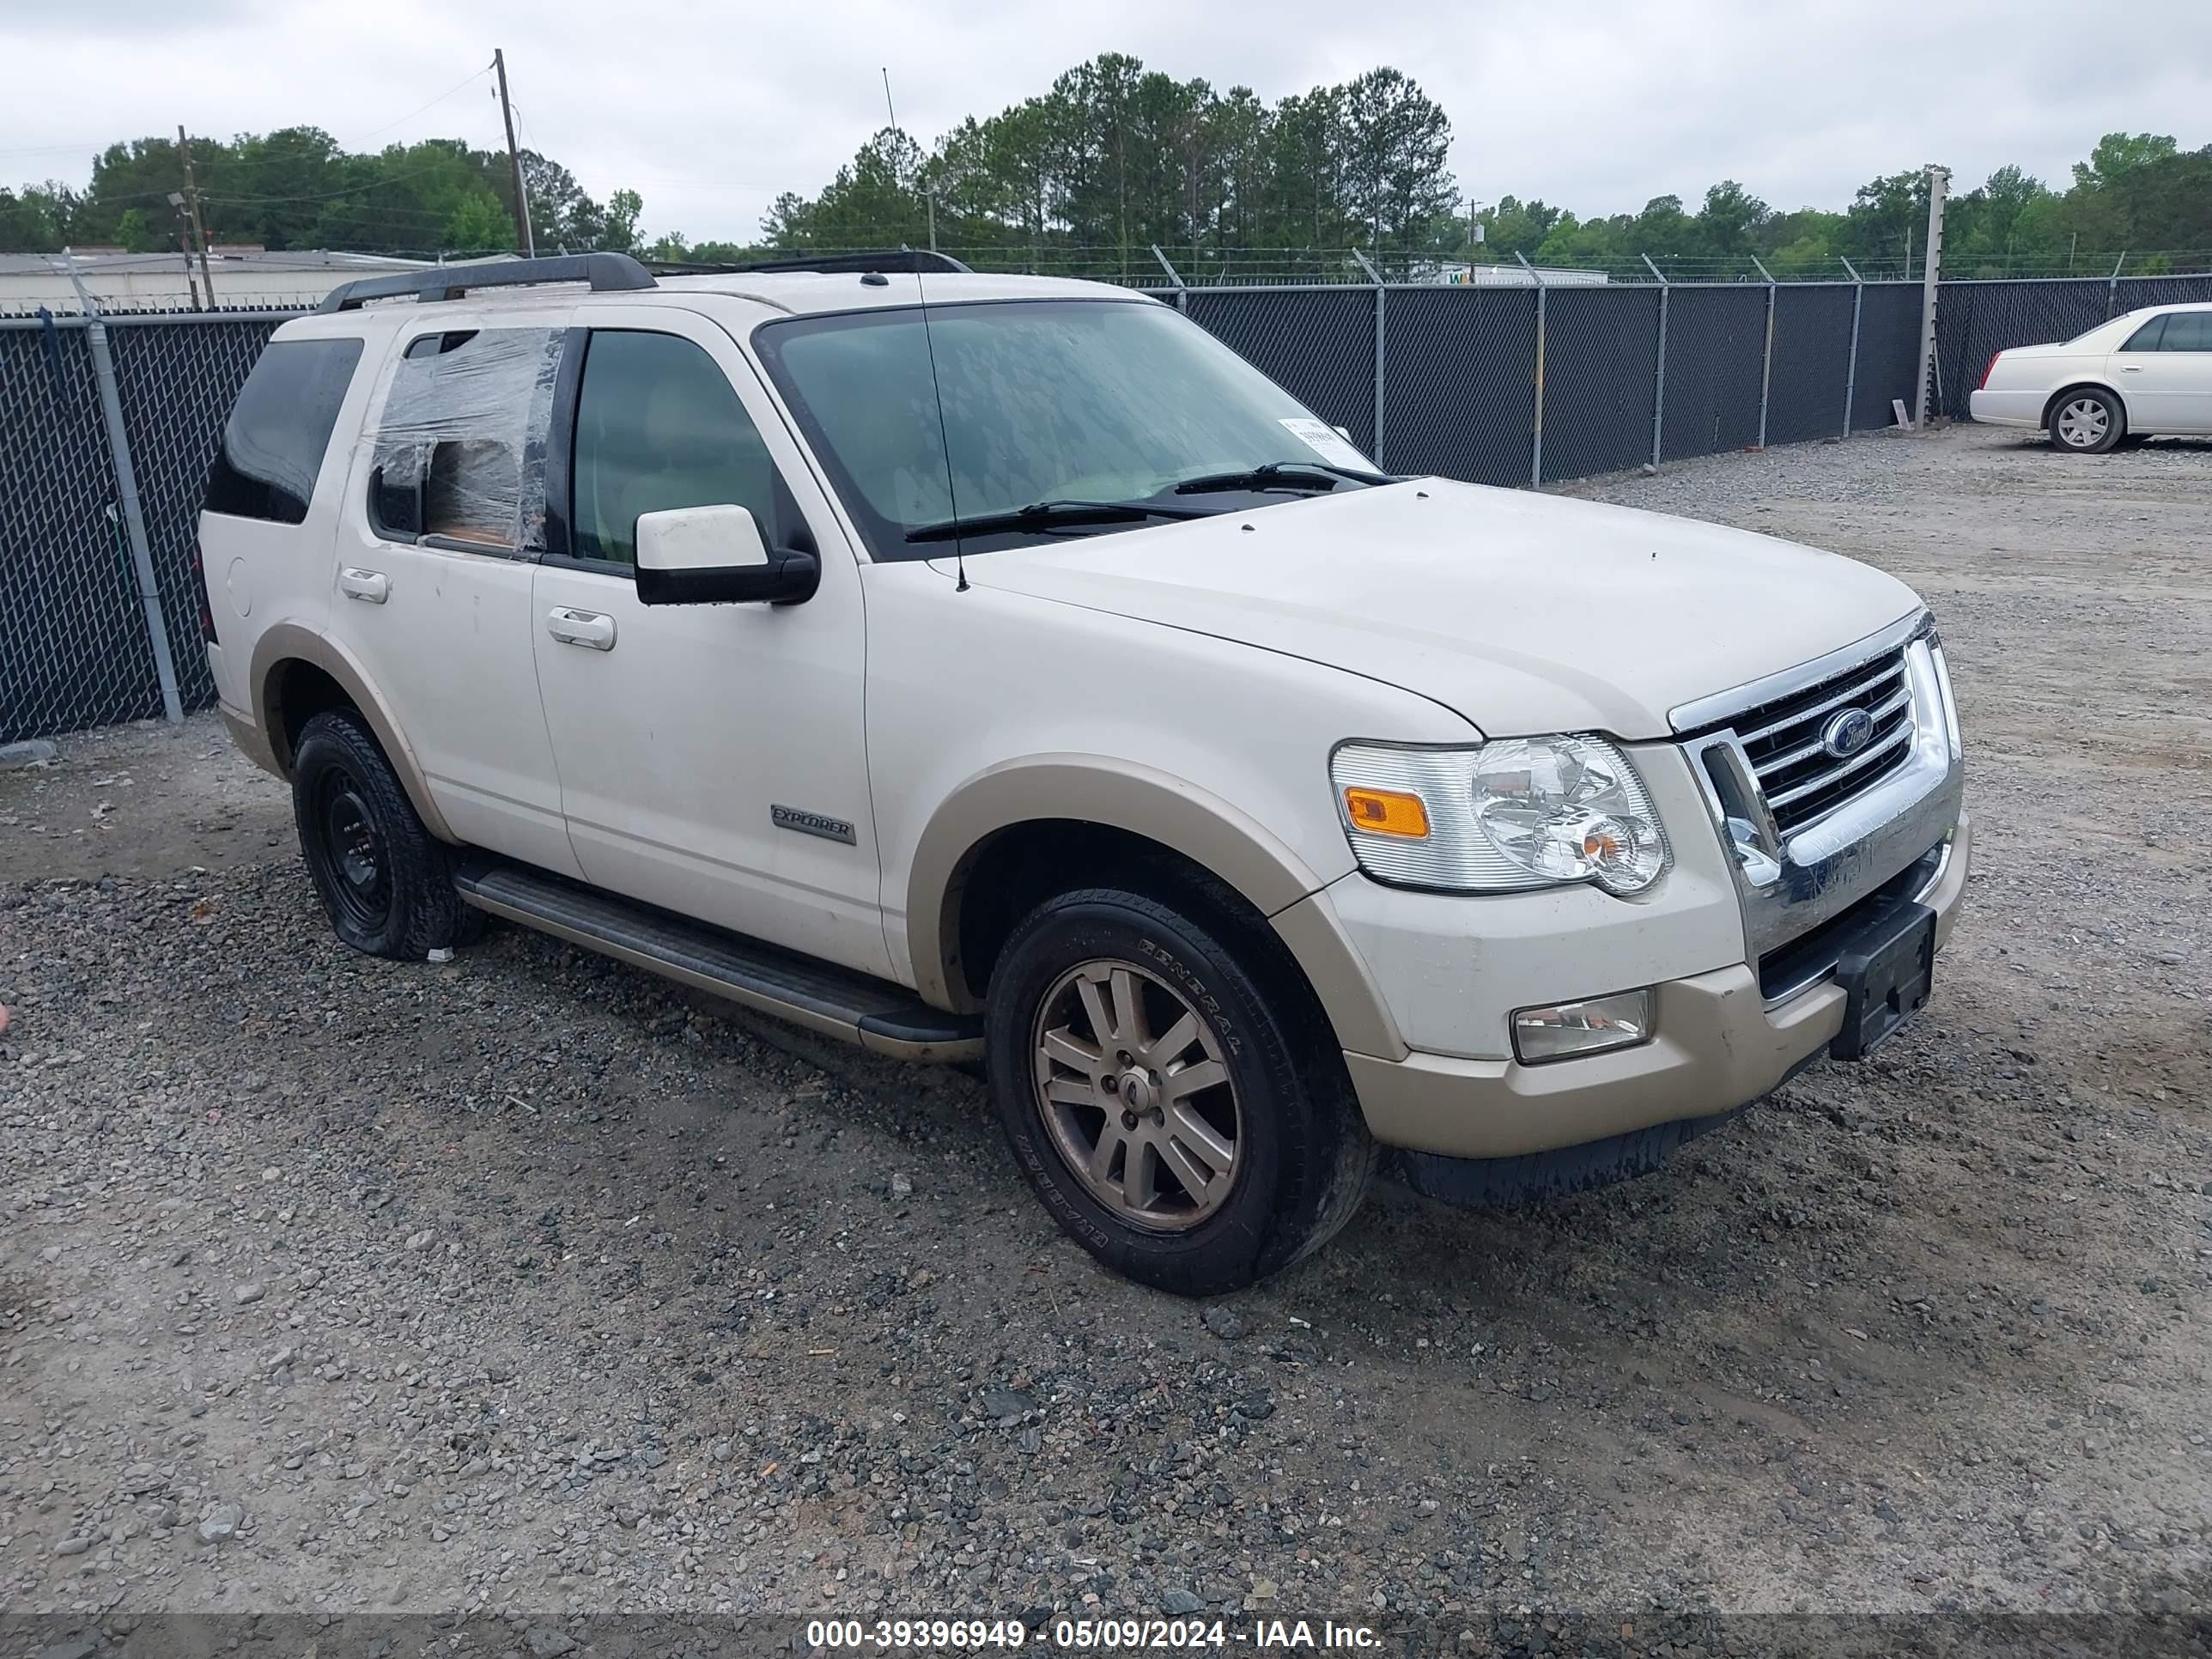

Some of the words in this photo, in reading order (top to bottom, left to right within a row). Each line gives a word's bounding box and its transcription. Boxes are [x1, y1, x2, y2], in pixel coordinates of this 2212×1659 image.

[1845, 720, 1869, 748] Ford
[772, 807, 849, 836] EXPLORER
[1138, 937, 1243, 1056] GENERAL
[1016, 1133, 1109, 1249] GRABBER
